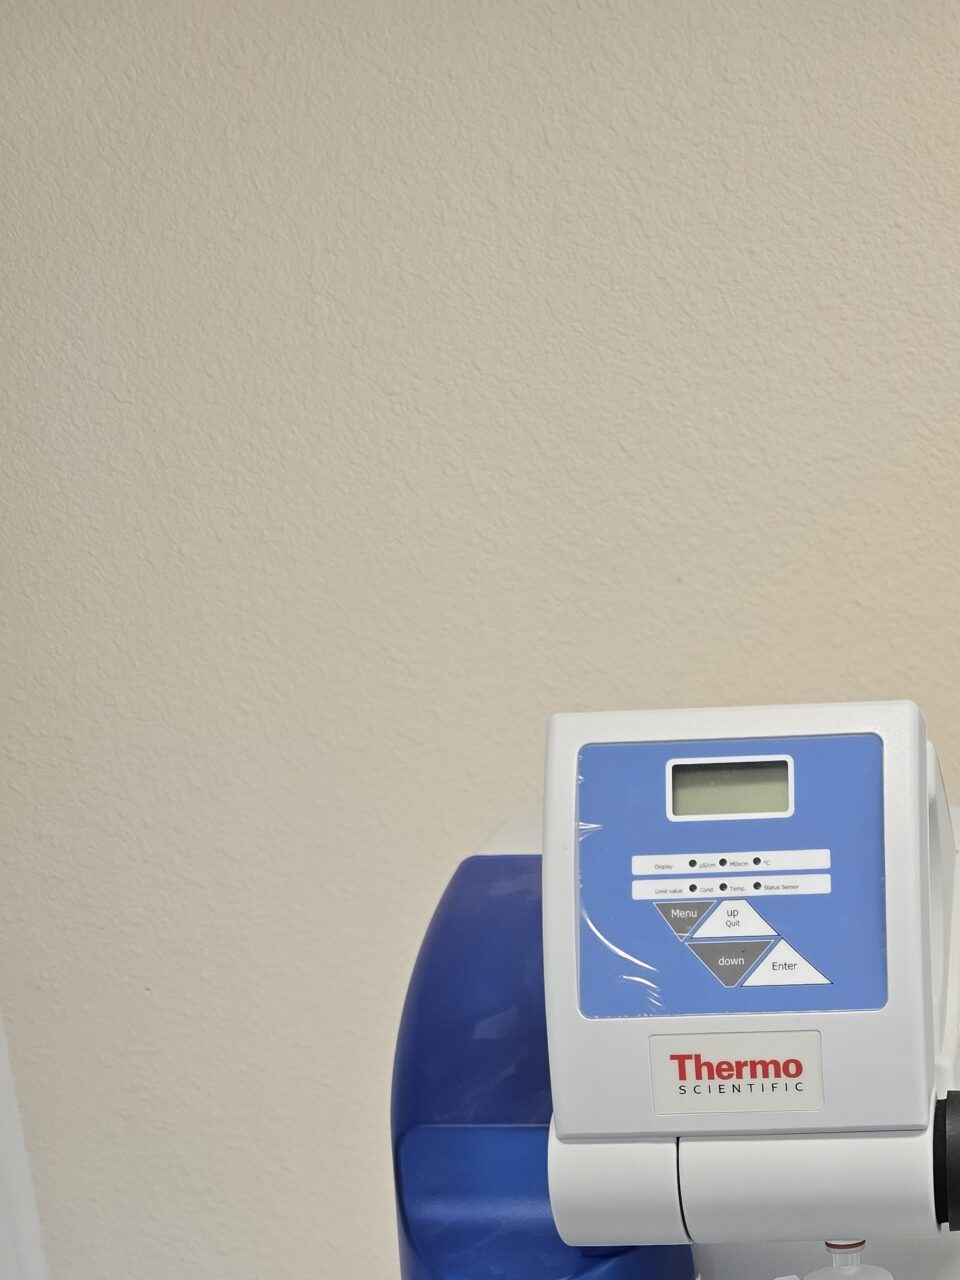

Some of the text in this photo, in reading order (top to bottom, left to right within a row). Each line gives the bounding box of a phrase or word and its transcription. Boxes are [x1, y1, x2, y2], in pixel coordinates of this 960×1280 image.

[671, 908, 739, 918] Menu up
[725, 919, 741, 927] Quit
[718, 956, 745, 965] down
[771, 961, 798, 970] Enter
[669, 1053, 804, 1081] Thermo
[678, 1082, 804, 1095] SCIENTIFIC
